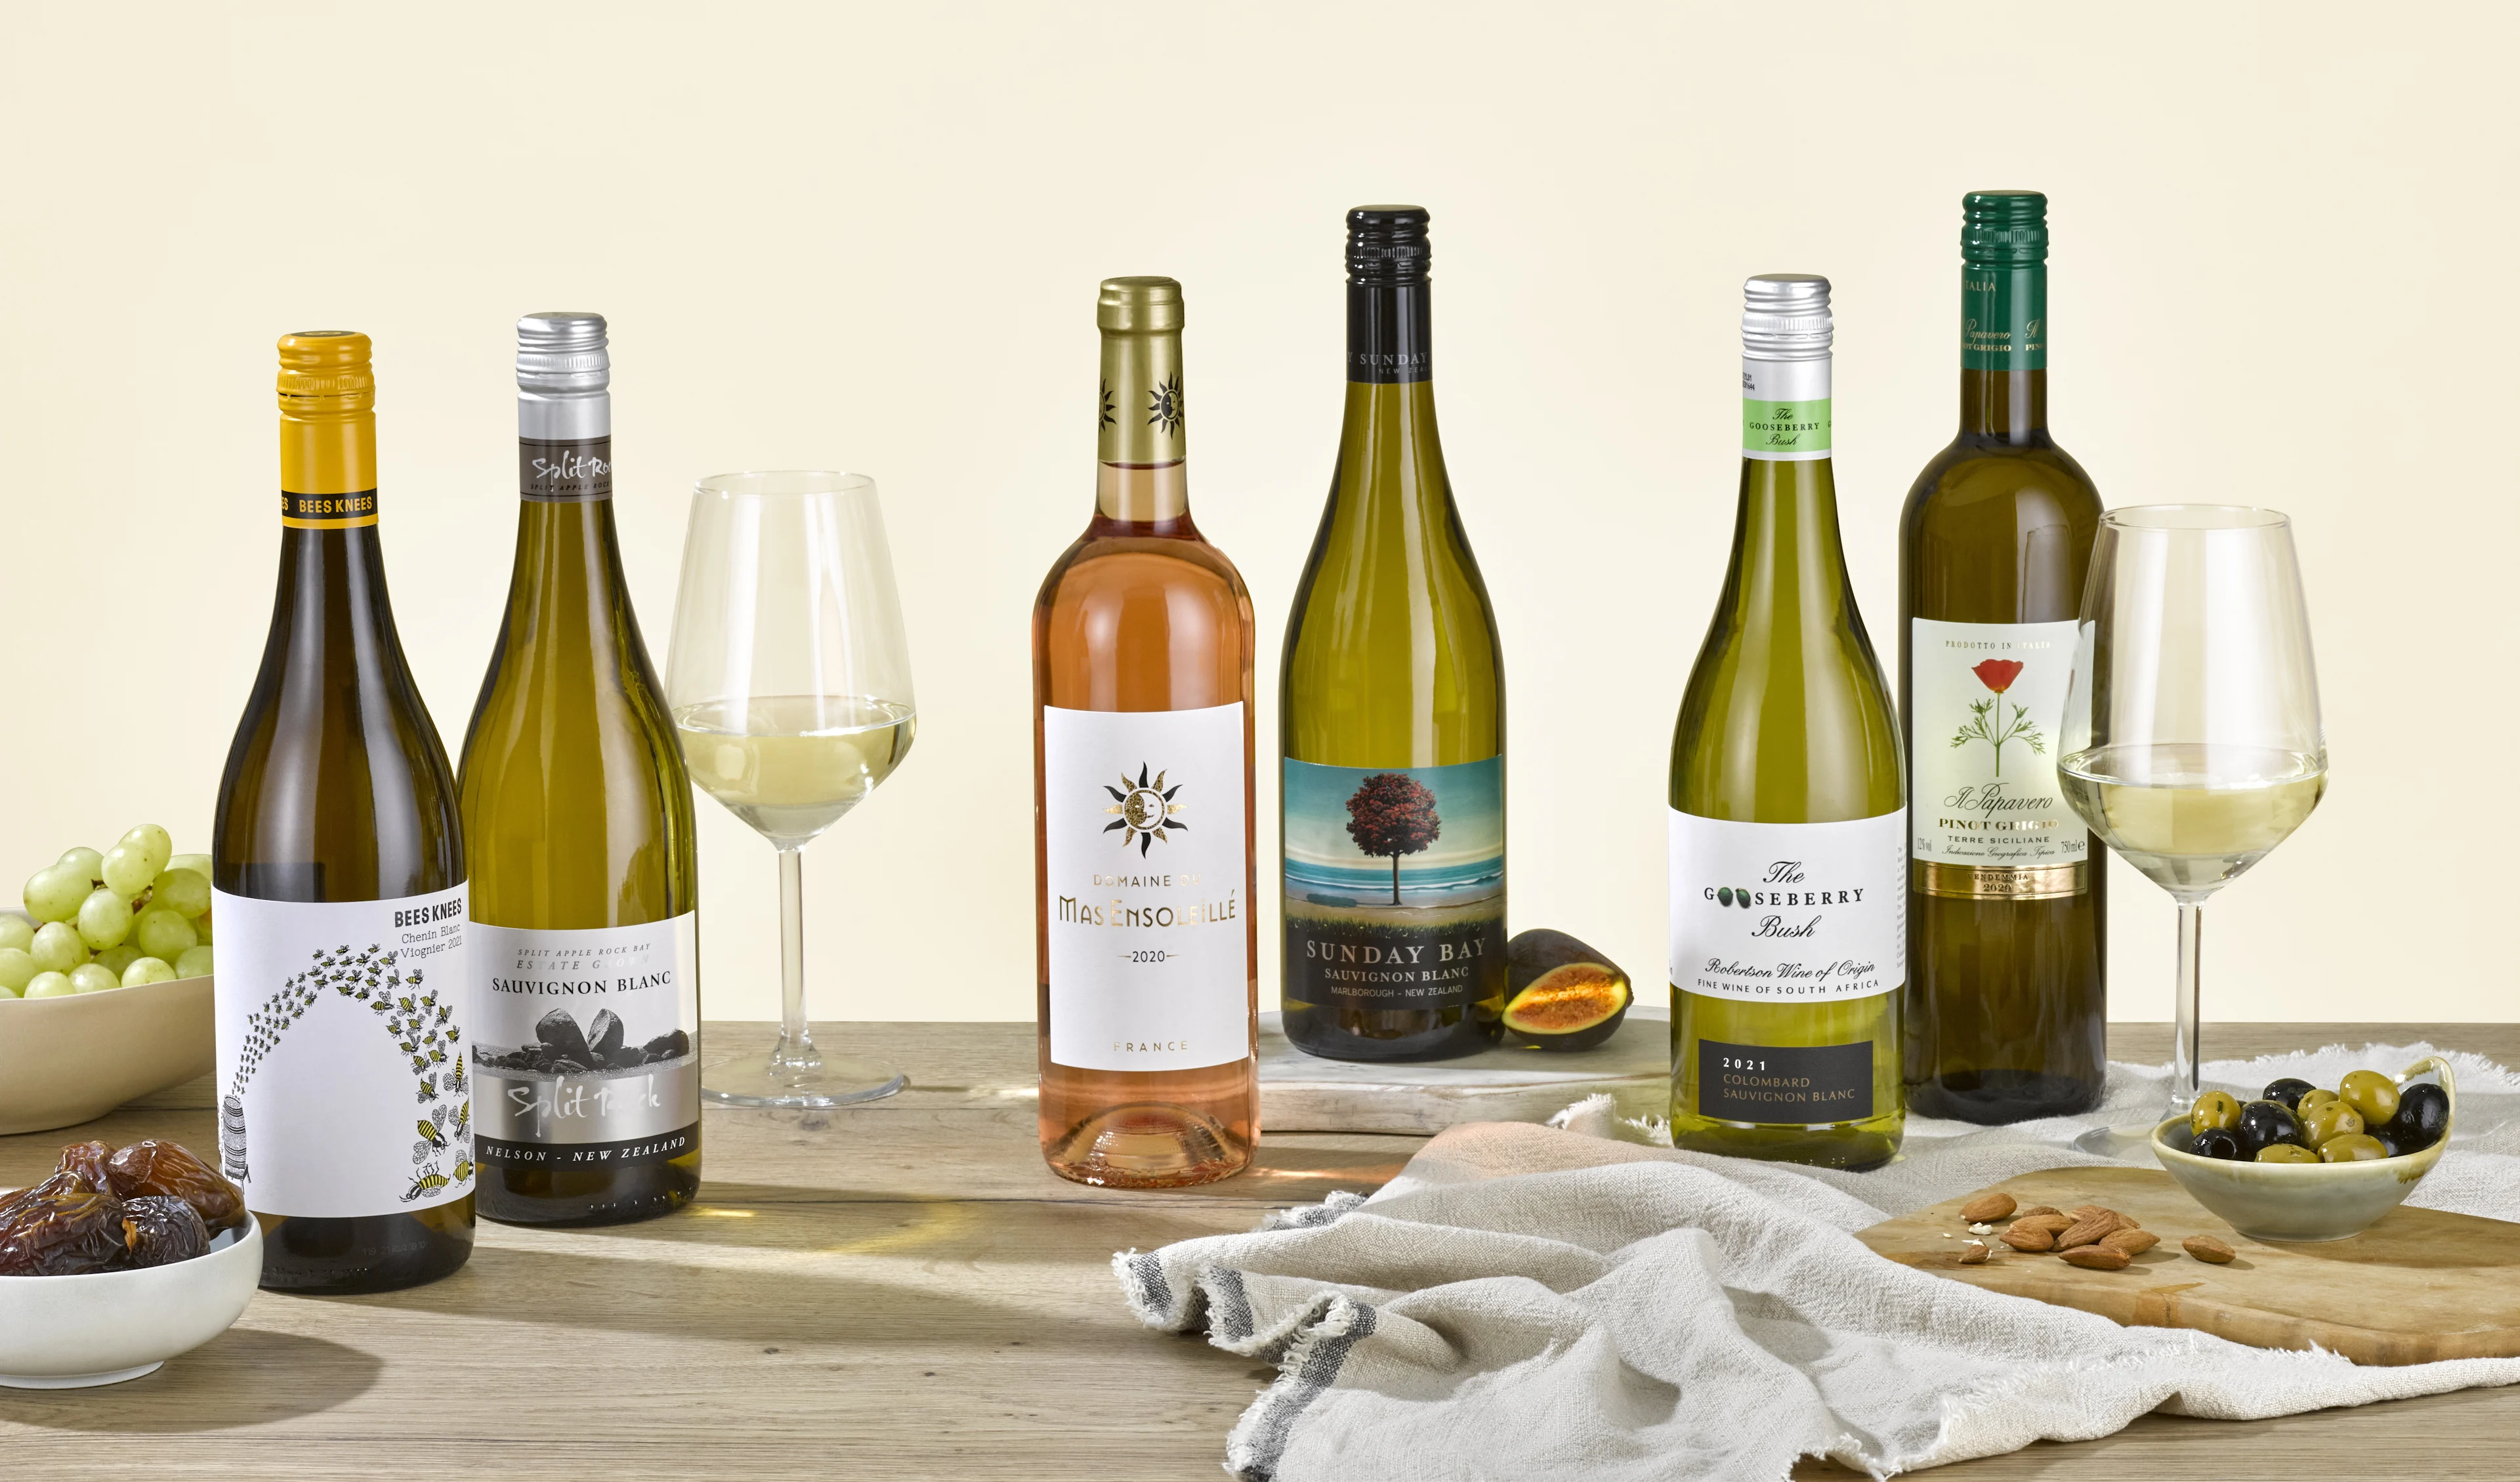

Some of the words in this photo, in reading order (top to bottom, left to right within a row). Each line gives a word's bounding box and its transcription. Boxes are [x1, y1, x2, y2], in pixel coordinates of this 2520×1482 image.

[1360, 352, 1427, 365] SUNDAY
[1772, 408, 1794, 420] The
[1750, 421, 1819, 431] GOOSEBERRY
[1765, 433, 1801, 446] Bush
[532, 450, 587, 492] Split
[299, 499, 332, 513] BEES
[335, 496, 373, 513] KNEES
[1946, 640, 1996, 650] PRODOTTO
[1944, 786, 1975, 809] Il
[1964, 782, 2053, 818] Papavero
[1939, 818, 1991, 831] PINOT
[1996, 819, 2059, 832] GRIGIO
[1942, 845, 1985, 857] Indicazione
[1987, 846, 2027, 860] Geografica
[2030, 845, 2055, 859] Tipica
[1763, 861, 1805, 883] The
[1093, 875, 1171, 887] DOMAINE
[1180, 873, 1201, 886] DU
[394, 906, 429, 928] BEES
[432, 897, 462, 922] KNEES
[402, 930, 437, 944] Chenin
[440, 924, 461, 937] Blanc
[1751, 915, 1822, 938] Bush
[400, 943, 446, 959] Viognier
[448, 935, 462, 949] 2021
[598, 946, 627, 956] ROCK
[633, 943, 651, 952] BAY
[1307, 940, 1425, 964] SUNDAY
[1438, 937, 1487, 963] BAY
[516, 960, 581, 971] ESTATE
[1705, 958, 1773, 979] Robertson
[1776, 963, 1813, 979] Wine
[1815, 962, 1838, 982] of
[1838, 960, 1876, 980] Origin
[1324, 967, 1415, 983] SAUVIGNON
[1421, 967, 1469, 982] BLANC
[492, 977, 607, 995] SAUVIGNON
[617, 971, 671, 992] BLANC
[1698, 978, 1717, 990] FINE
[1722, 983, 1750, 993] WINE
[1755, 986, 1771, 994] OF
[1777, 986, 1826, 994] SOUTH
[1836, 979, 1879, 993] AFRICA
[1331, 986, 1394, 998] MARLBOROUGH
[1405, 988, 1425, 997] NEW
[1428, 984, 1463, 996] ZEALAND
[1114, 1040, 1188, 1052] FRANCE
[1723, 1057, 1765, 1071] 2021
[1723, 1074, 1810, 1088] COLOMBARD
[1723, 1088, 1806, 1103] SAUVIGNON
[1813, 1089, 1855, 1102] BLANC
[507, 1075, 591, 1137] Split
[486, 1145, 547, 1162] NELSON
[572, 1150, 612, 1162] NEW
[621, 1136, 686, 1158] ZEALAND
